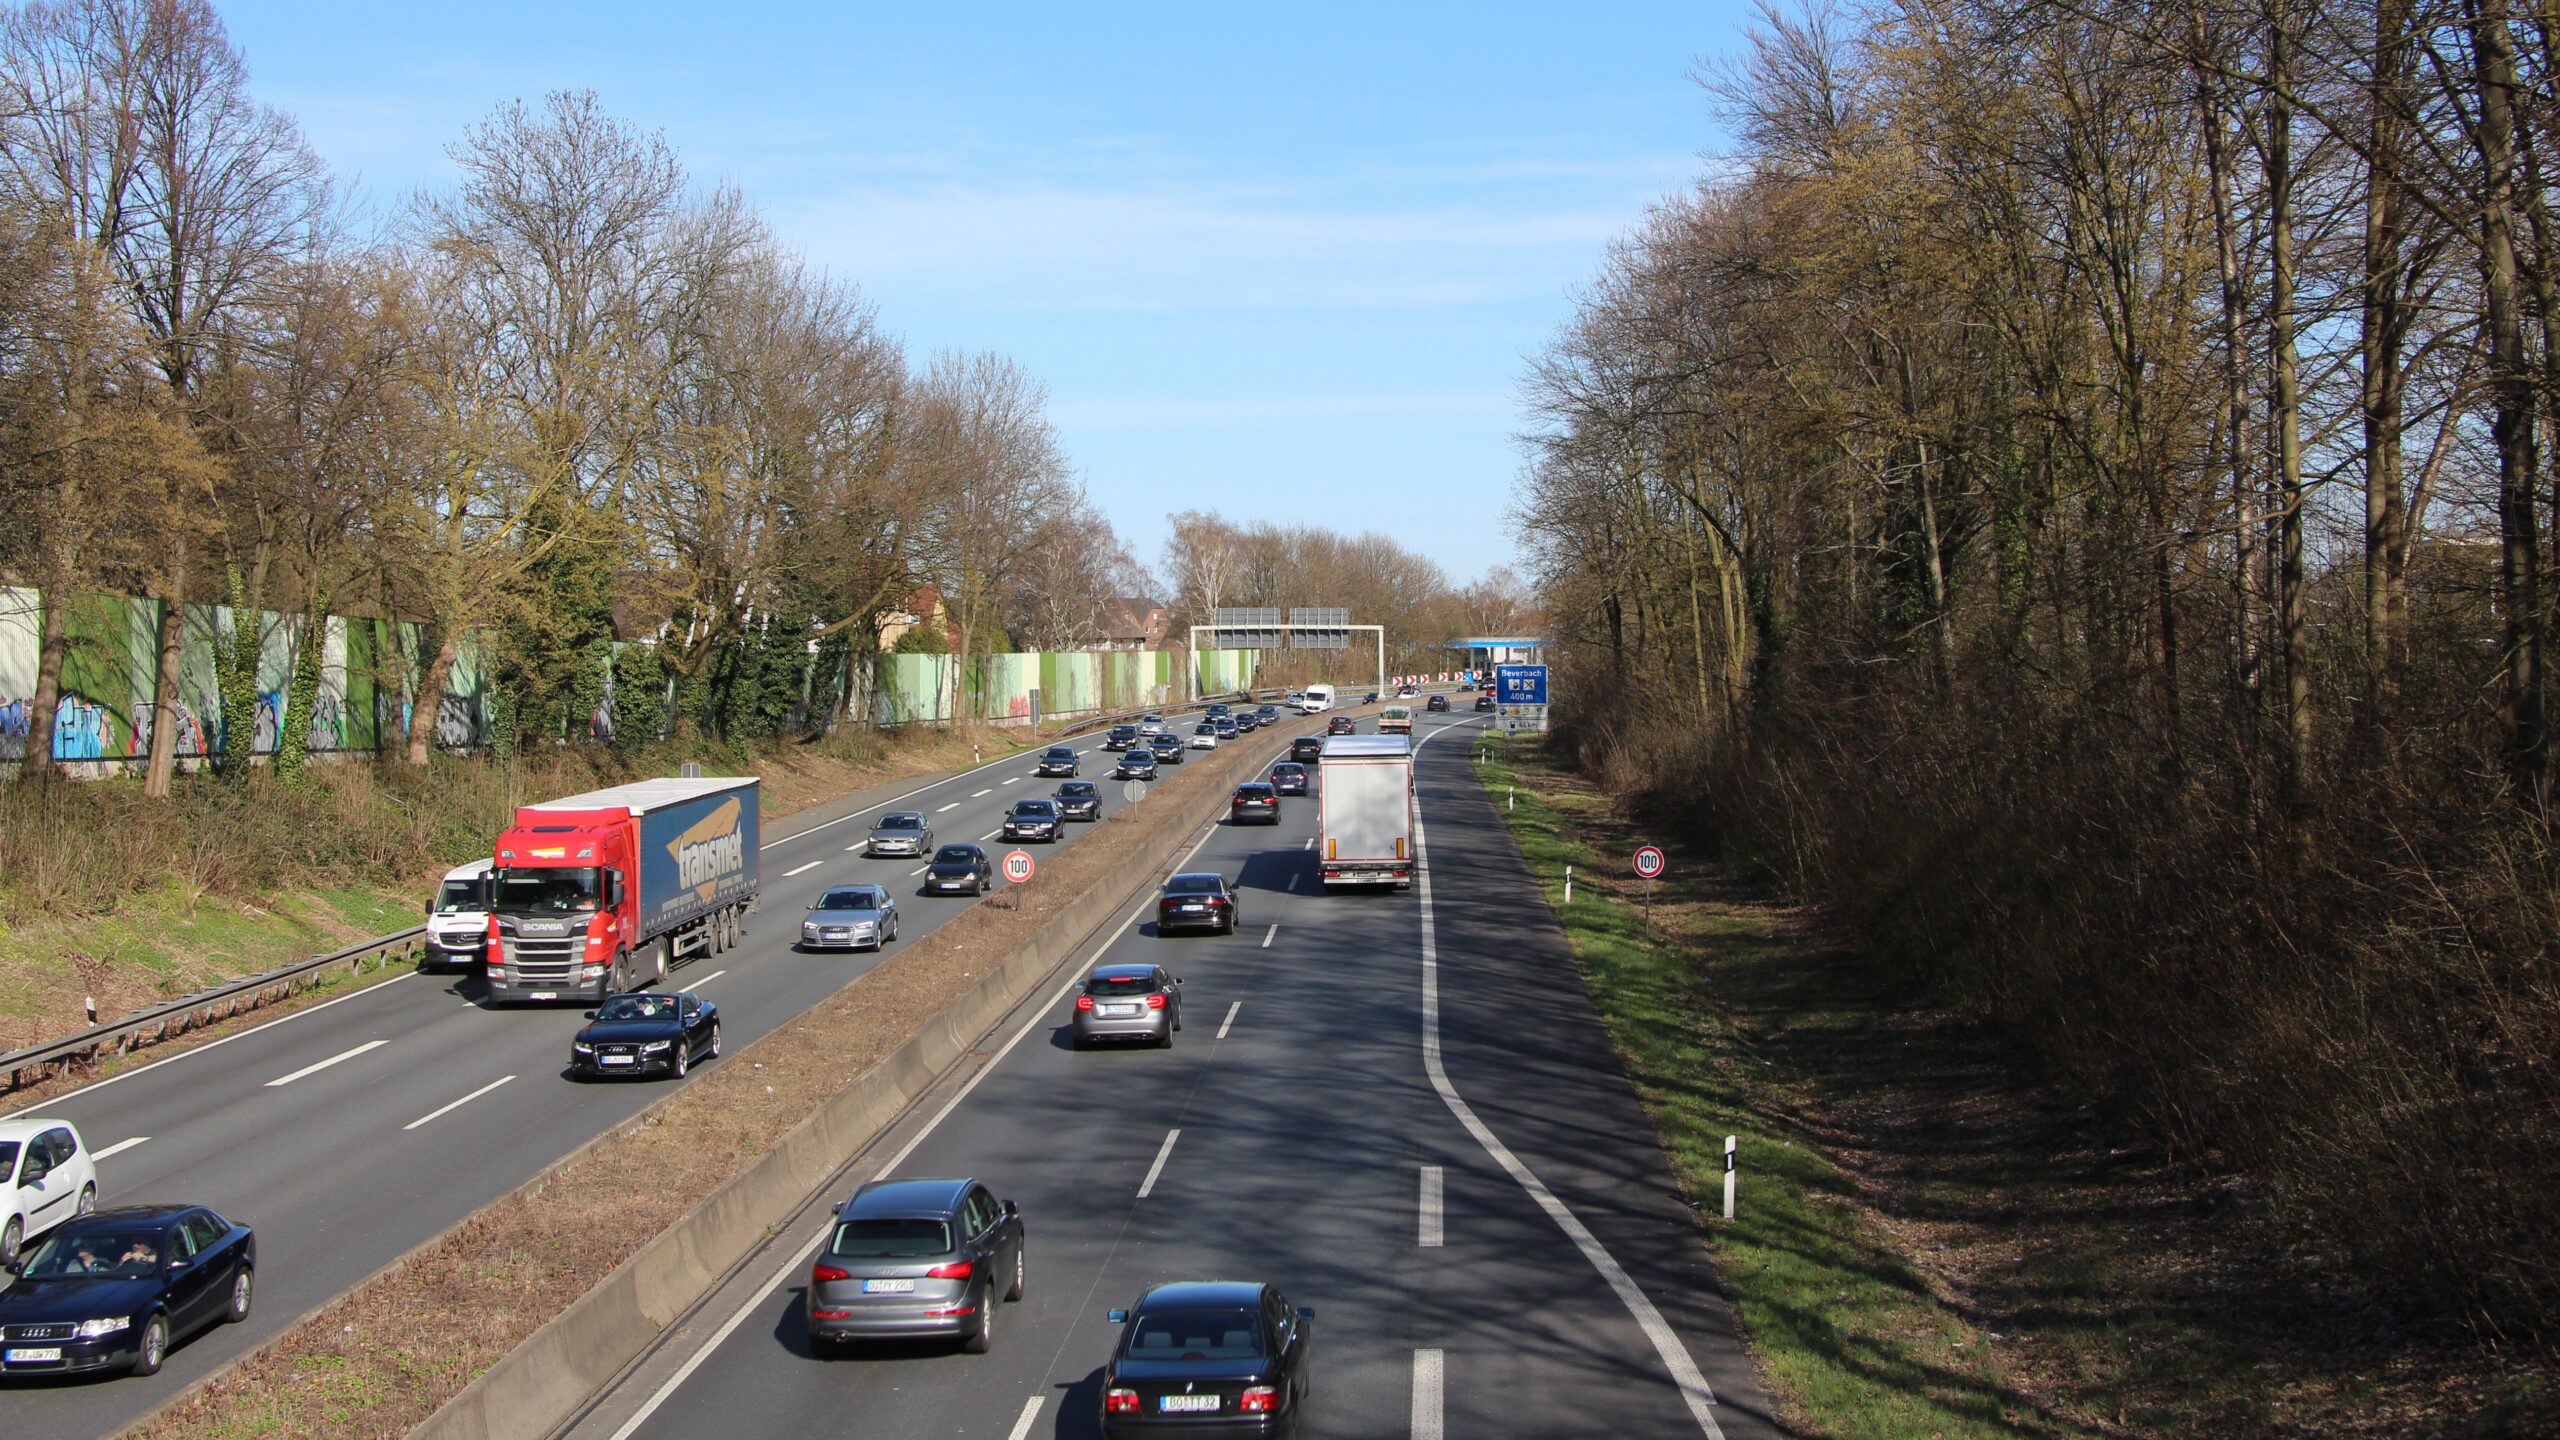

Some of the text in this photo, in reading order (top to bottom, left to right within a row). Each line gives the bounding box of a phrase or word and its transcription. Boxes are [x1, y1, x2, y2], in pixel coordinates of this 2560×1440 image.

[1501, 669, 1542, 677] Beverbach
[1510, 692, 1524, 701] 400
[678, 820, 743, 890] transmet
[1010, 860, 1027, 873] 100
[1640, 855, 1657, 869] 100
[522, 923, 564, 931] SCANIA
[1169, 1396, 1183, 1408] BO
[1203, 1396, 1216, 1408] 32
